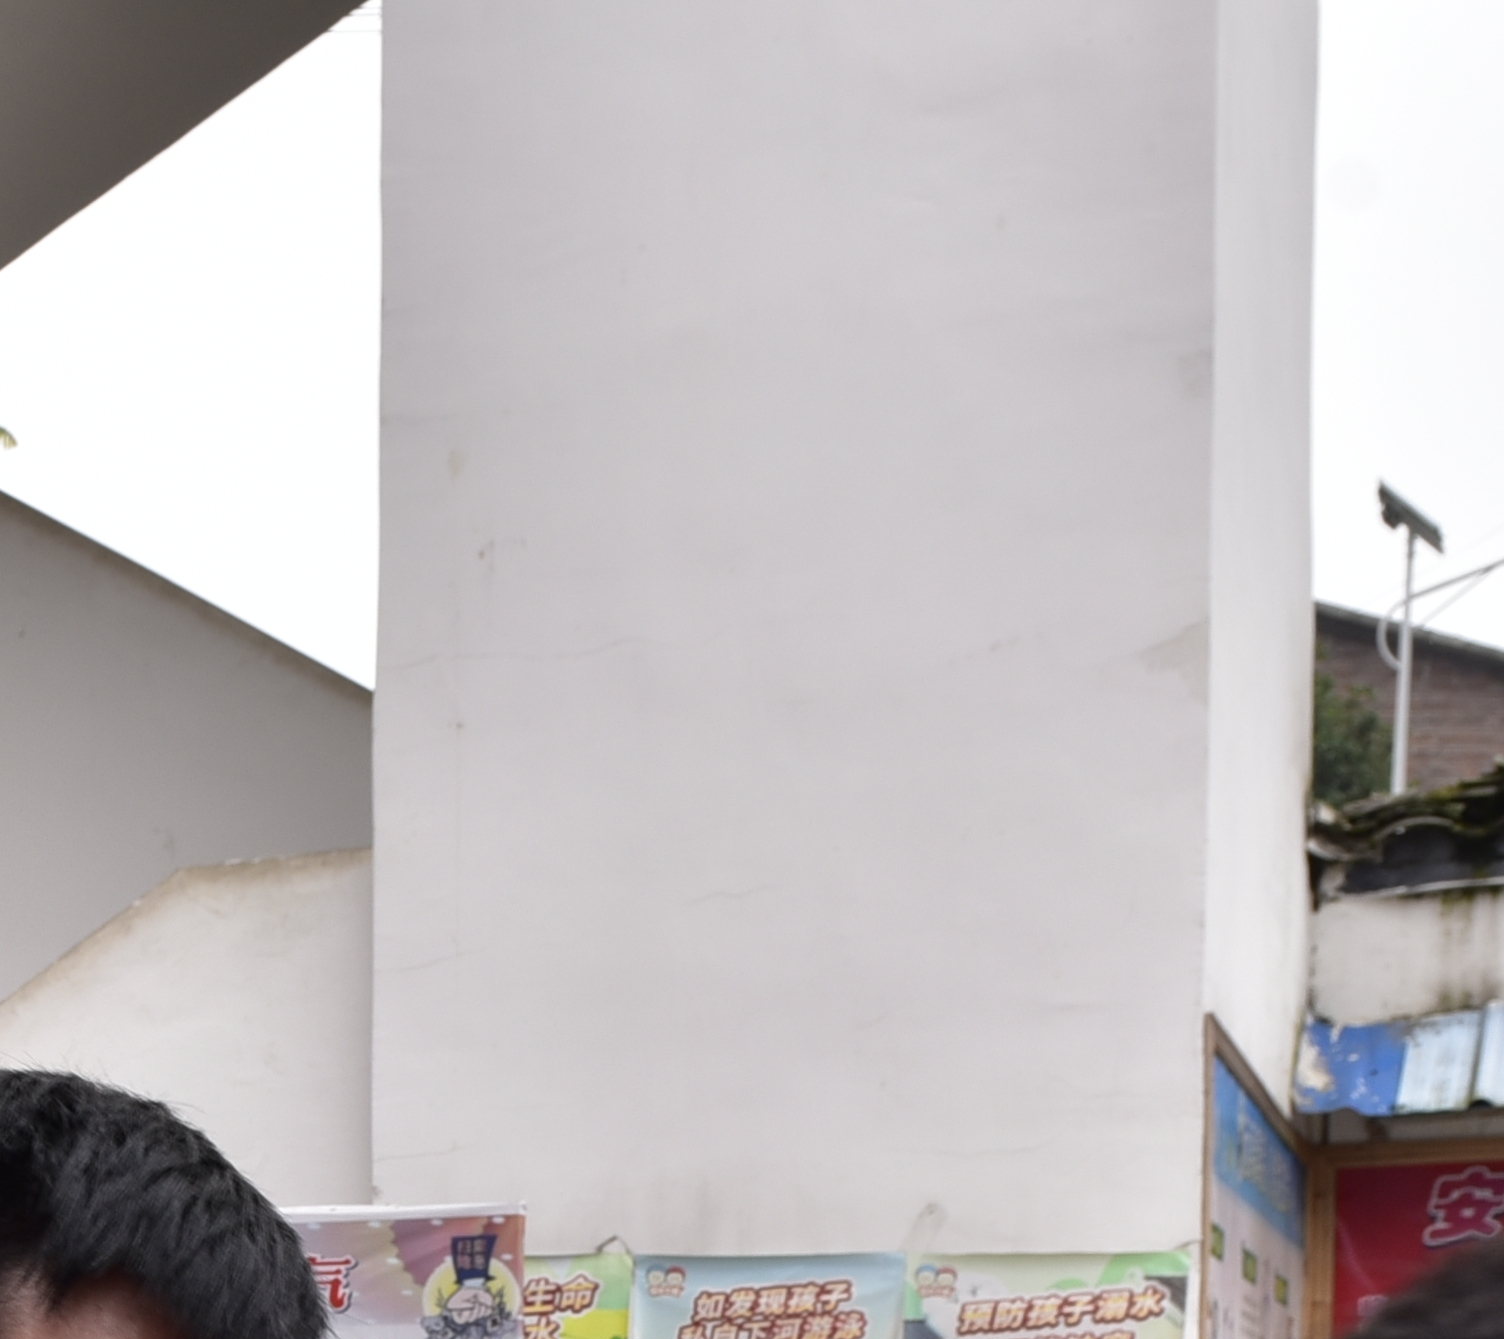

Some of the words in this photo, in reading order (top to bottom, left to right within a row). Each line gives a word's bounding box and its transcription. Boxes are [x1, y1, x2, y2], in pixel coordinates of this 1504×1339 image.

[693, 1280, 851, 1321] 如发现孩子
[957, 1284, 1166, 1335] 预防孩子溺水
